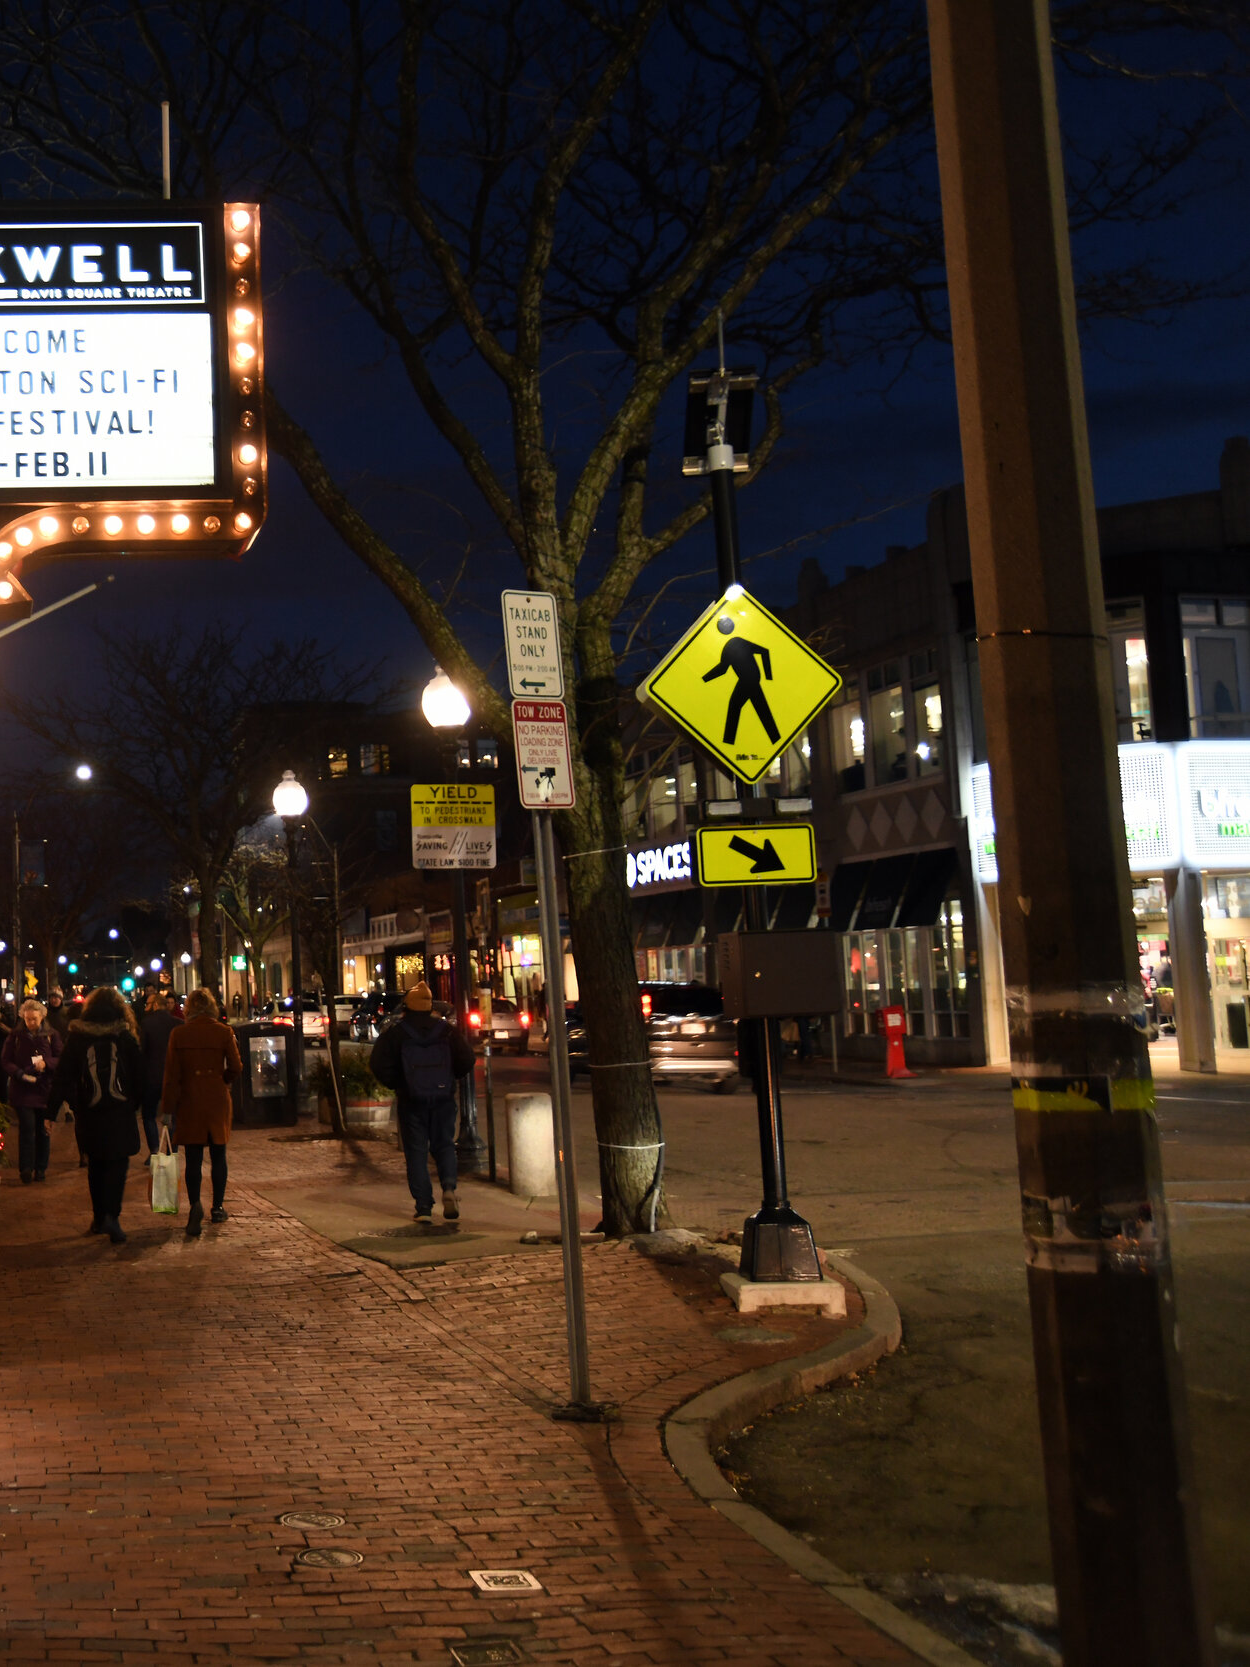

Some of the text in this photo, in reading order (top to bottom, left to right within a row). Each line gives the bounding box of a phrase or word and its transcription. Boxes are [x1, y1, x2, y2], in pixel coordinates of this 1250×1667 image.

[21, 287, 192, 299] DAVIS SQUARE THEATRE
[79, 369, 178, 394] SCI-FI
[509, 607, 551, 622] TAXICAB
[516, 625, 548, 640] STAND
[520, 643, 546, 658] ONLY
[516, 705, 563, 719] TOW ZONE
[518, 725, 564, 736] NO PARKING
[520, 738, 564, 747] LOADING ZONE
[527, 757, 561, 765] DELIVERIES
[430, 786, 477, 799] YIELD
[420, 806, 487, 815] TO PEDESTRIANS
[423, 816, 484, 825] IN CROSSWALK
[415, 841, 493, 852] SAVING LIVES
[439, 858, 455, 866] LAW
[476, 858, 491, 867] FINE
[636, 841, 691, 885] SPACES
